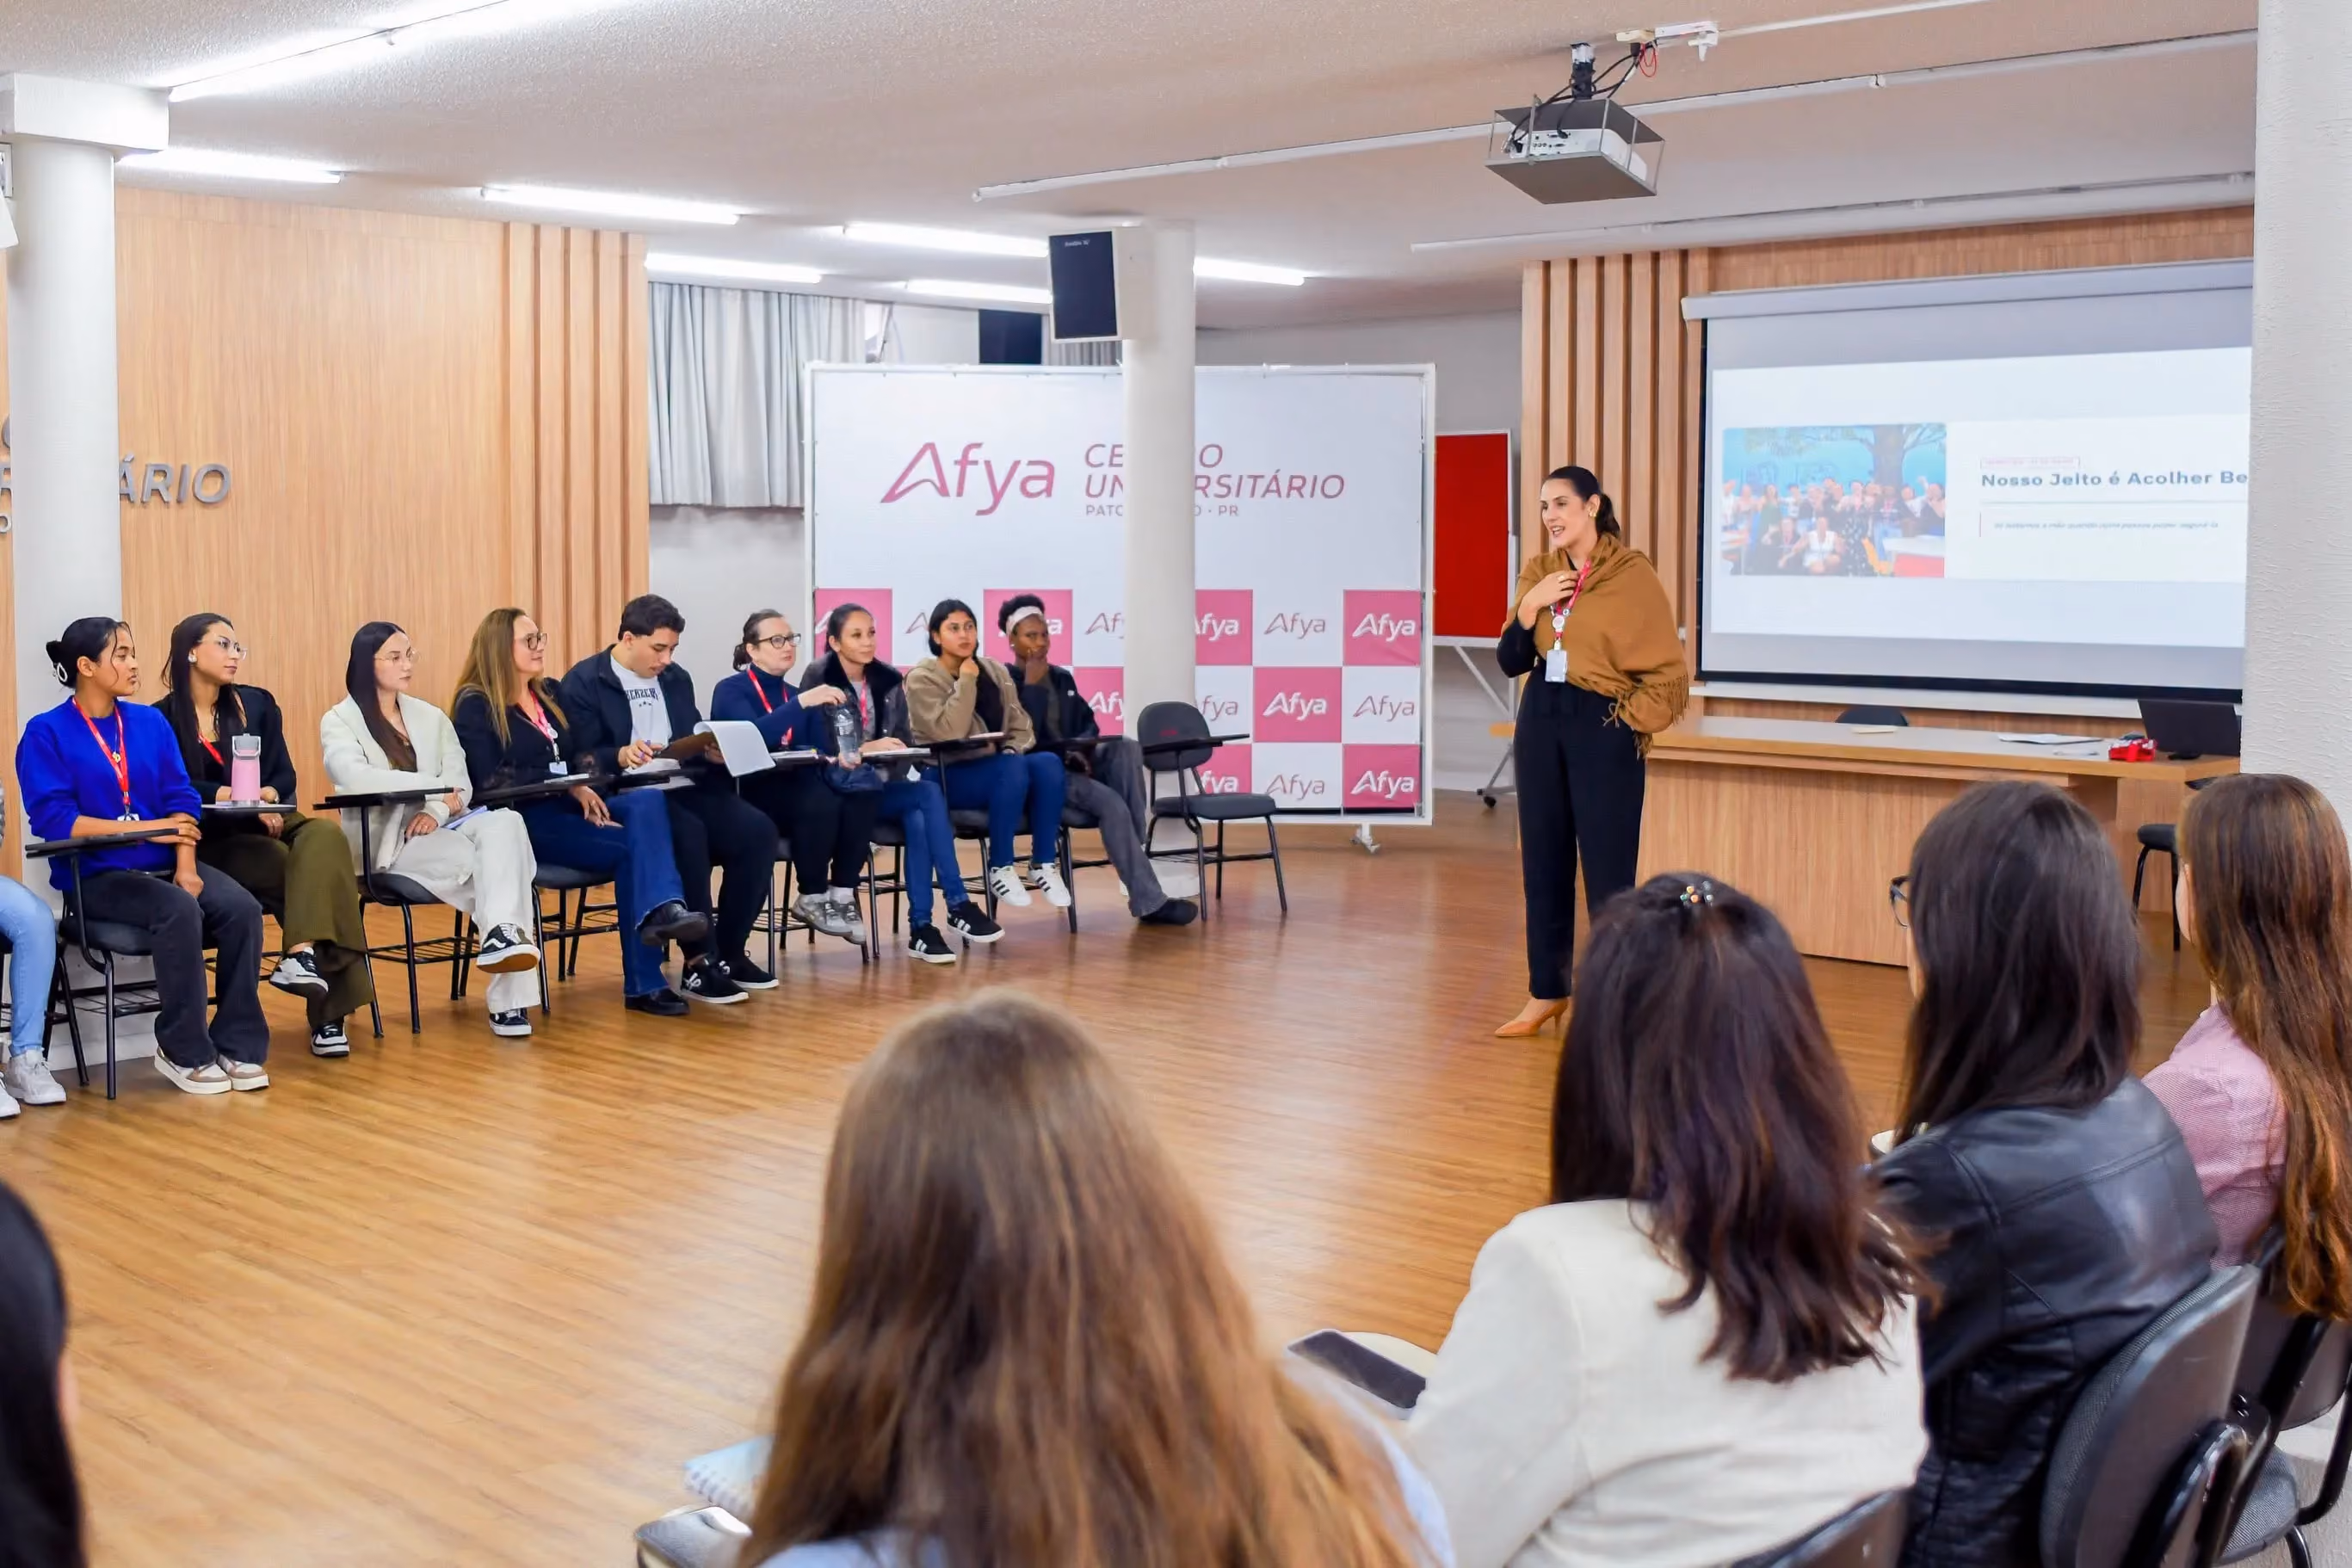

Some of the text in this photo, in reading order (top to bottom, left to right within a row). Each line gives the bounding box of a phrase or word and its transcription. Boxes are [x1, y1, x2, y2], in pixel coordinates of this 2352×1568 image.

[880, 442, 1055, 515] Afya
[1981, 474, 2043, 487] Nosso
[2127, 471, 2213, 485] Acolher
[1219, 504, 1239, 516] PR
[1263, 612, 1326, 639] Afya
[1352, 614, 1416, 642] Afya
[1201, 695, 1239, 722] fya
[1262, 692, 1327, 721] Afya
[1353, 695, 1416, 722] Afya
[1201, 770, 1239, 793] fya
[1266, 774, 1326, 801] Afya
[1350, 770, 1416, 799] Afya
